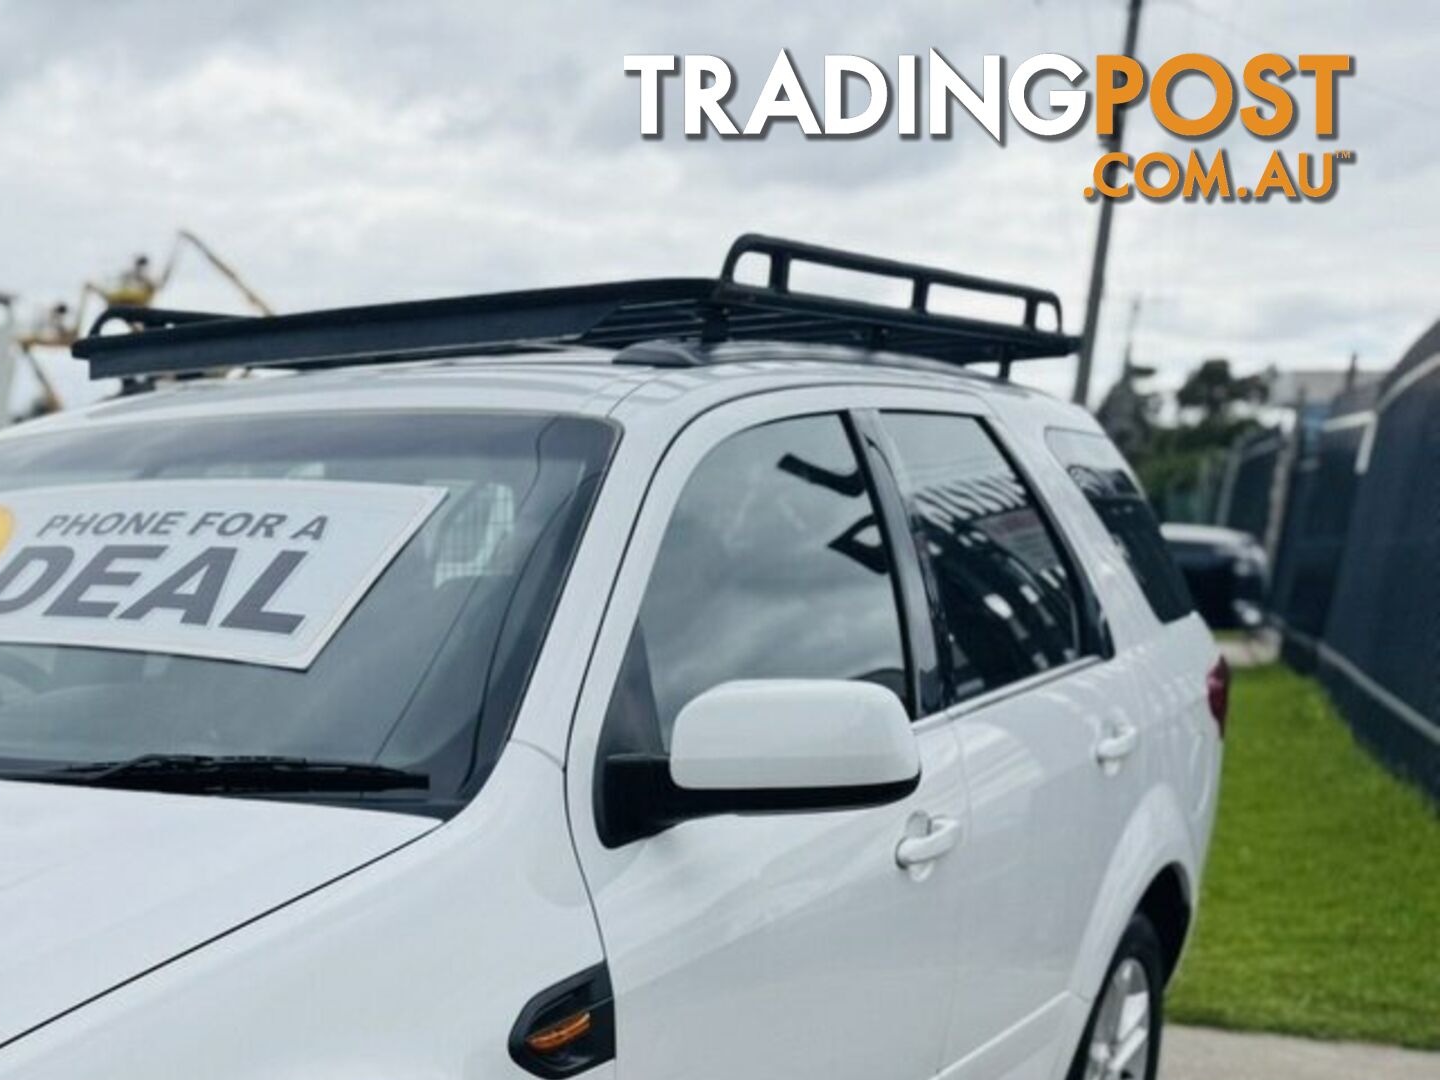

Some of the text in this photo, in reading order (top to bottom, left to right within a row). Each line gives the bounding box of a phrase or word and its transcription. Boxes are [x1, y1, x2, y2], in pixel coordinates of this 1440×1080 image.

[36, 511, 330, 541] PHONE FOR A
